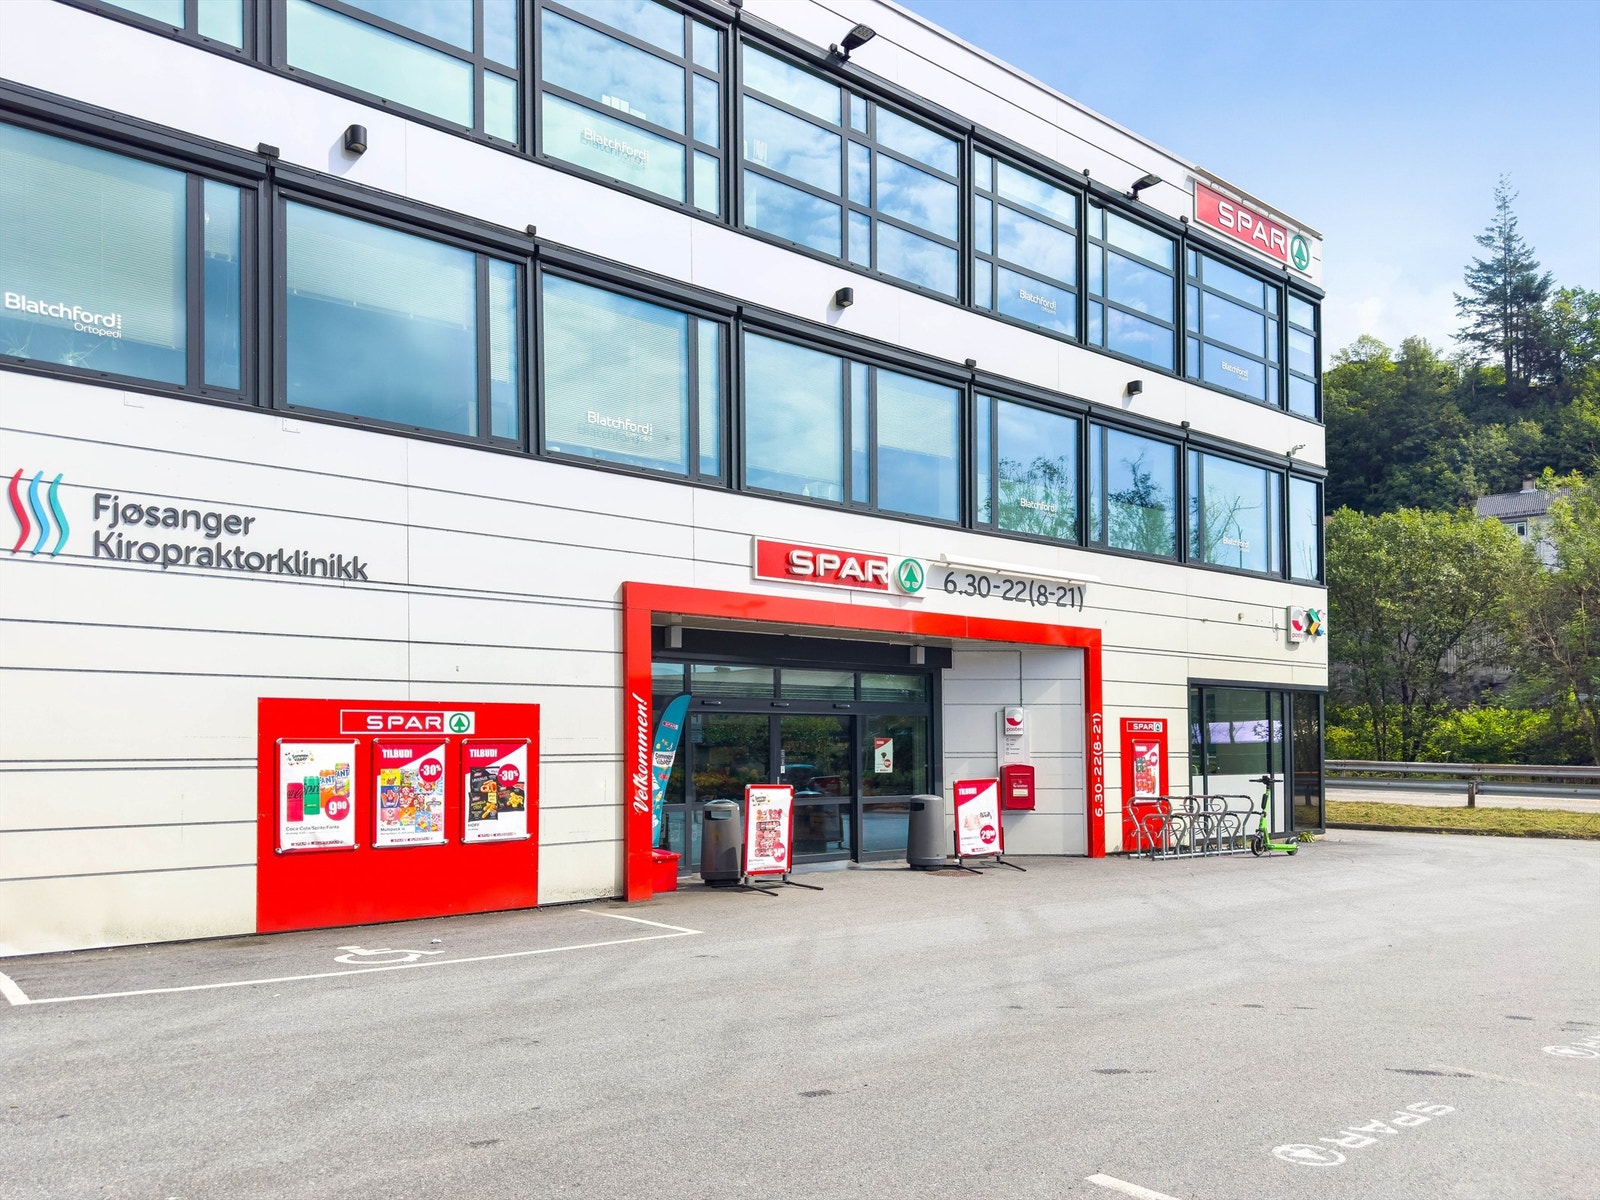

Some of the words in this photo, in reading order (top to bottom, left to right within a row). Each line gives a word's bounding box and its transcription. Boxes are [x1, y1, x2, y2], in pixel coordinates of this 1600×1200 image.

[1219, 200, 1285, 255] SPAR
[5, 292, 121, 328] Blatchford
[74, 322, 121, 339] Ortopedi
[587, 410, 652, 435] Blatchford
[94, 493, 255, 538] Fjøsanger
[94, 530, 368, 581] Kiropraktorklinikk
[788, 550, 888, 583] SPAR
[943, 571, 1084, 612] 6.30-22(8-21)
[366, 715, 441, 730] SPAR
[382, 749, 413, 758] TILBUD!
[469, 748, 498, 757] TILBUD!
[632, 692, 649, 816] Velkommen!
[420, 764, 442, 776] -30%
[499, 770, 518, 781] -30%
[1319, 1101, 1455, 1149] SPAR
